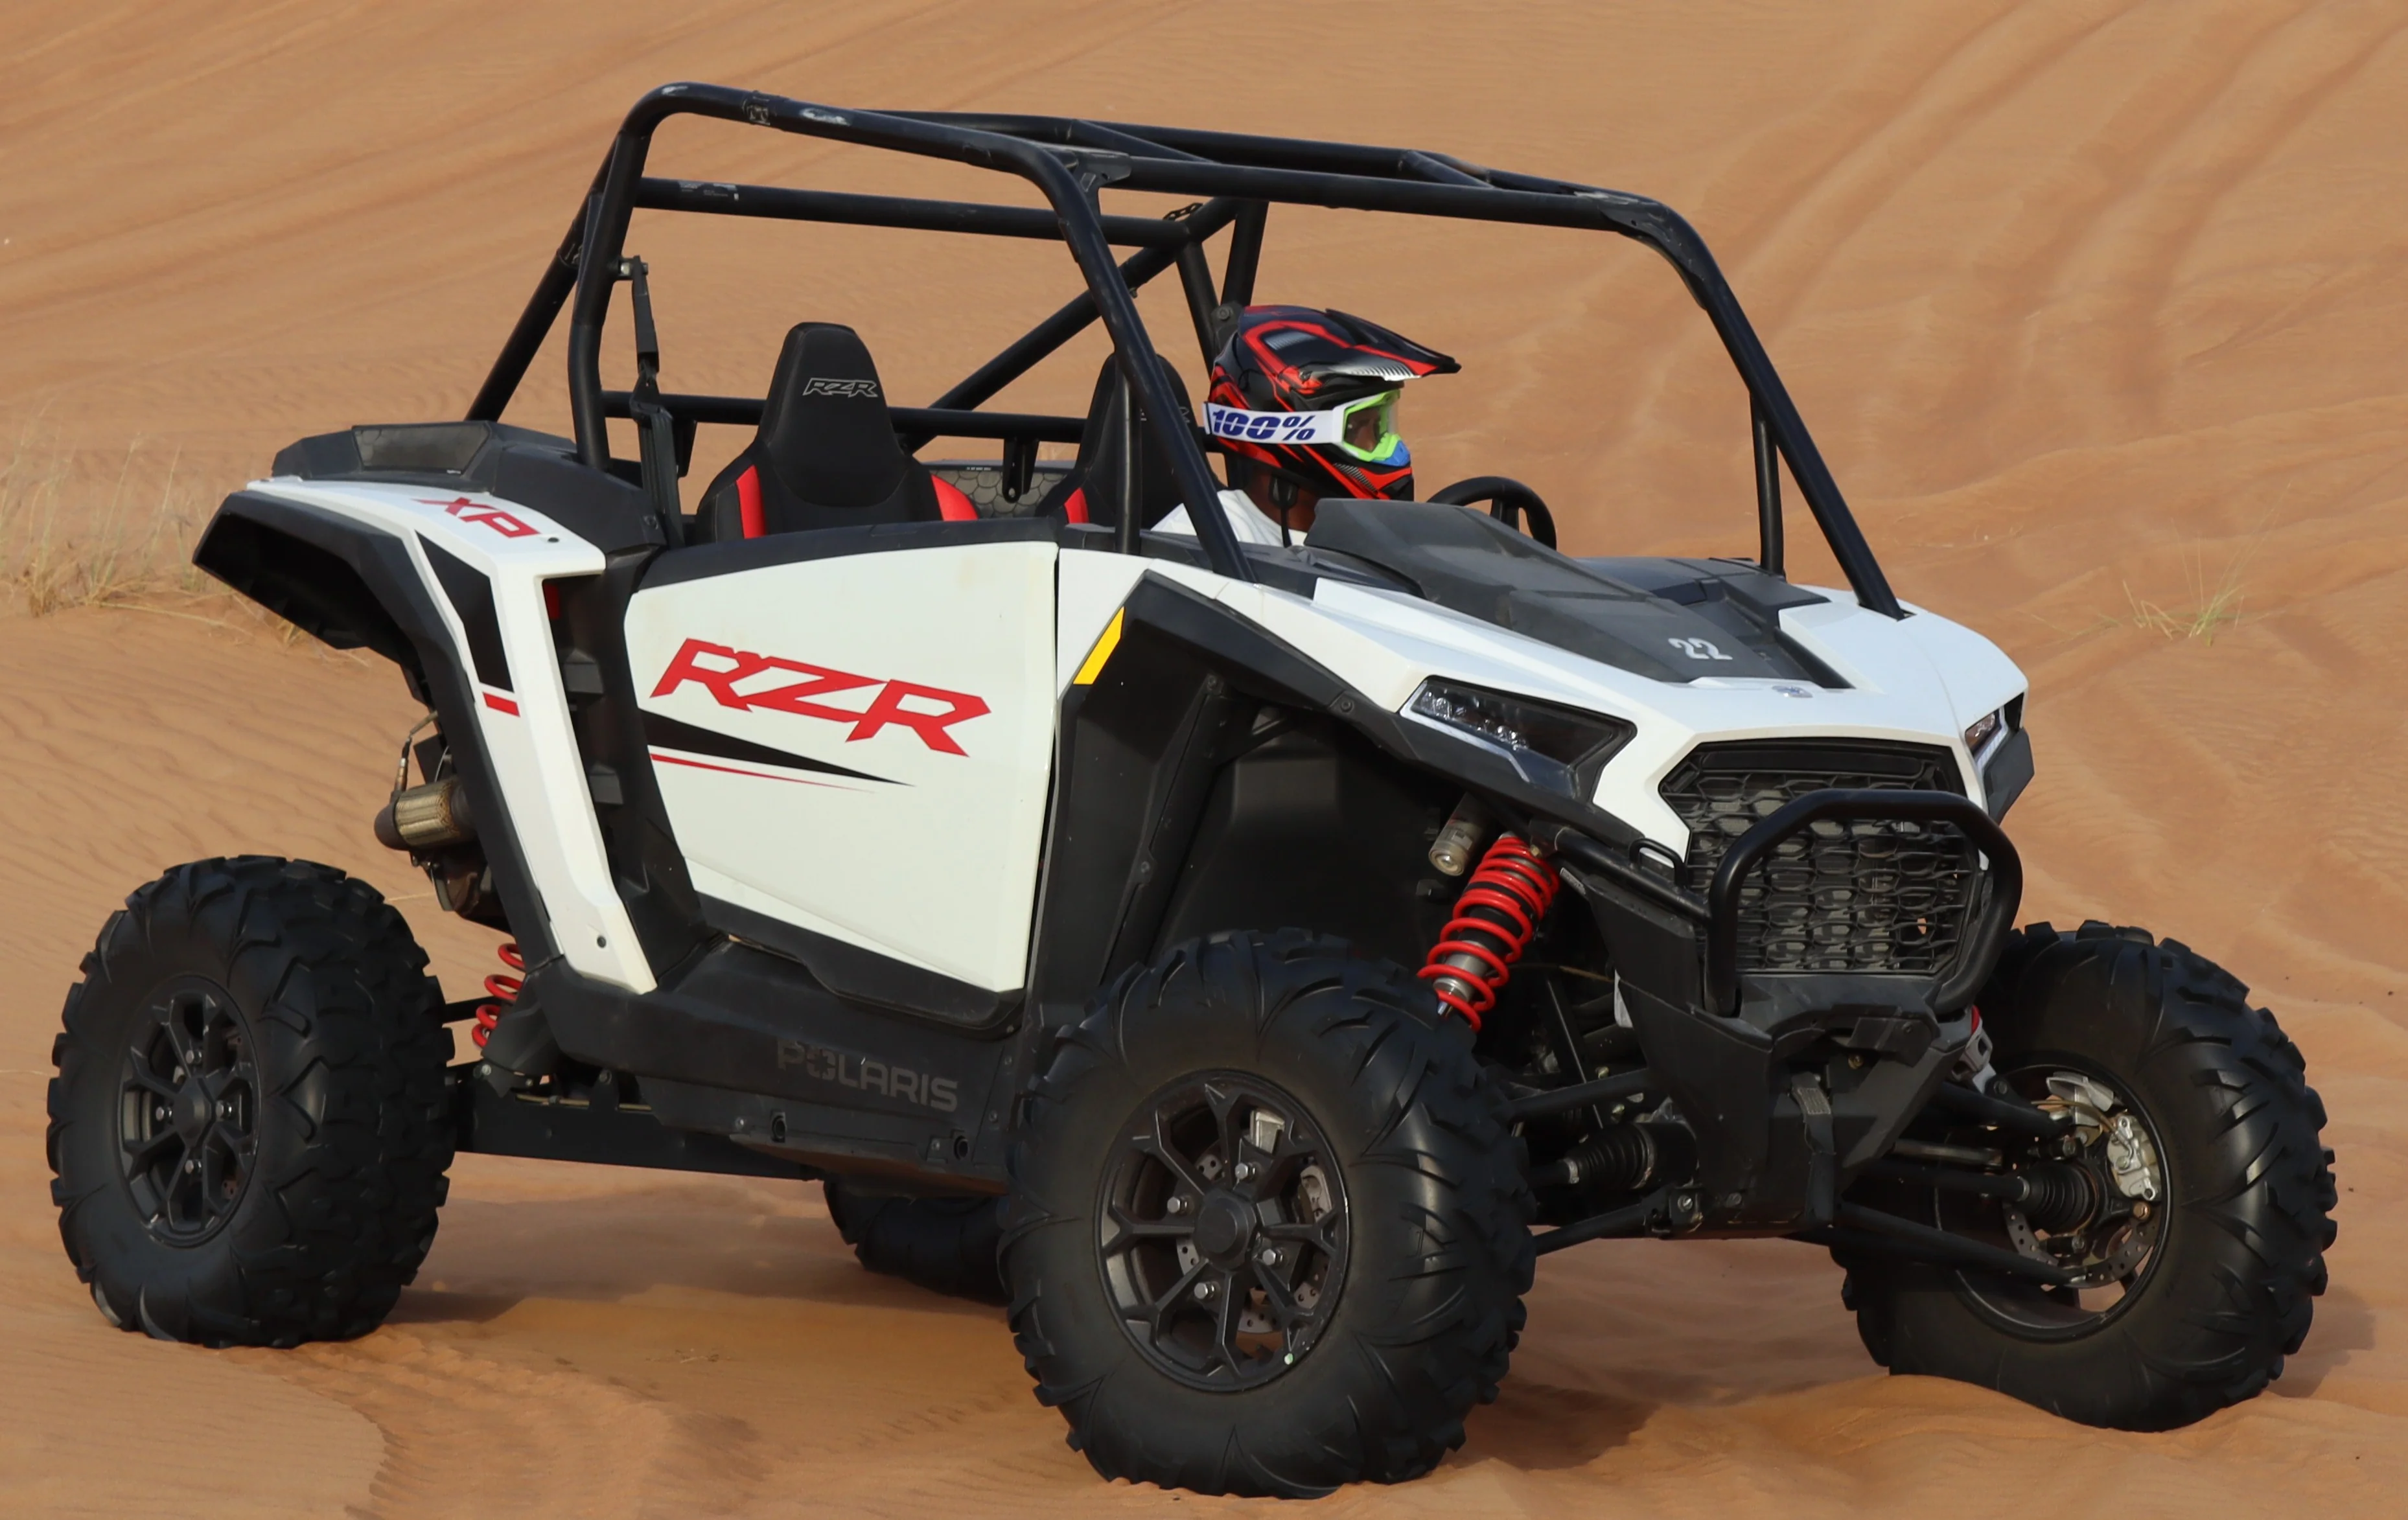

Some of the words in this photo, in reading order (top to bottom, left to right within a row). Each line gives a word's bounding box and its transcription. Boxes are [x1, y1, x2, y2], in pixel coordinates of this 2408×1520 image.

[802, 377, 878, 398] RZR
[1212, 409, 1316, 441] 100%
[410, 496, 541, 538] XP
[1668, 638, 1733, 660] 22
[649, 638, 991, 757] RZR
[778, 1039, 958, 1112] POLARIS
